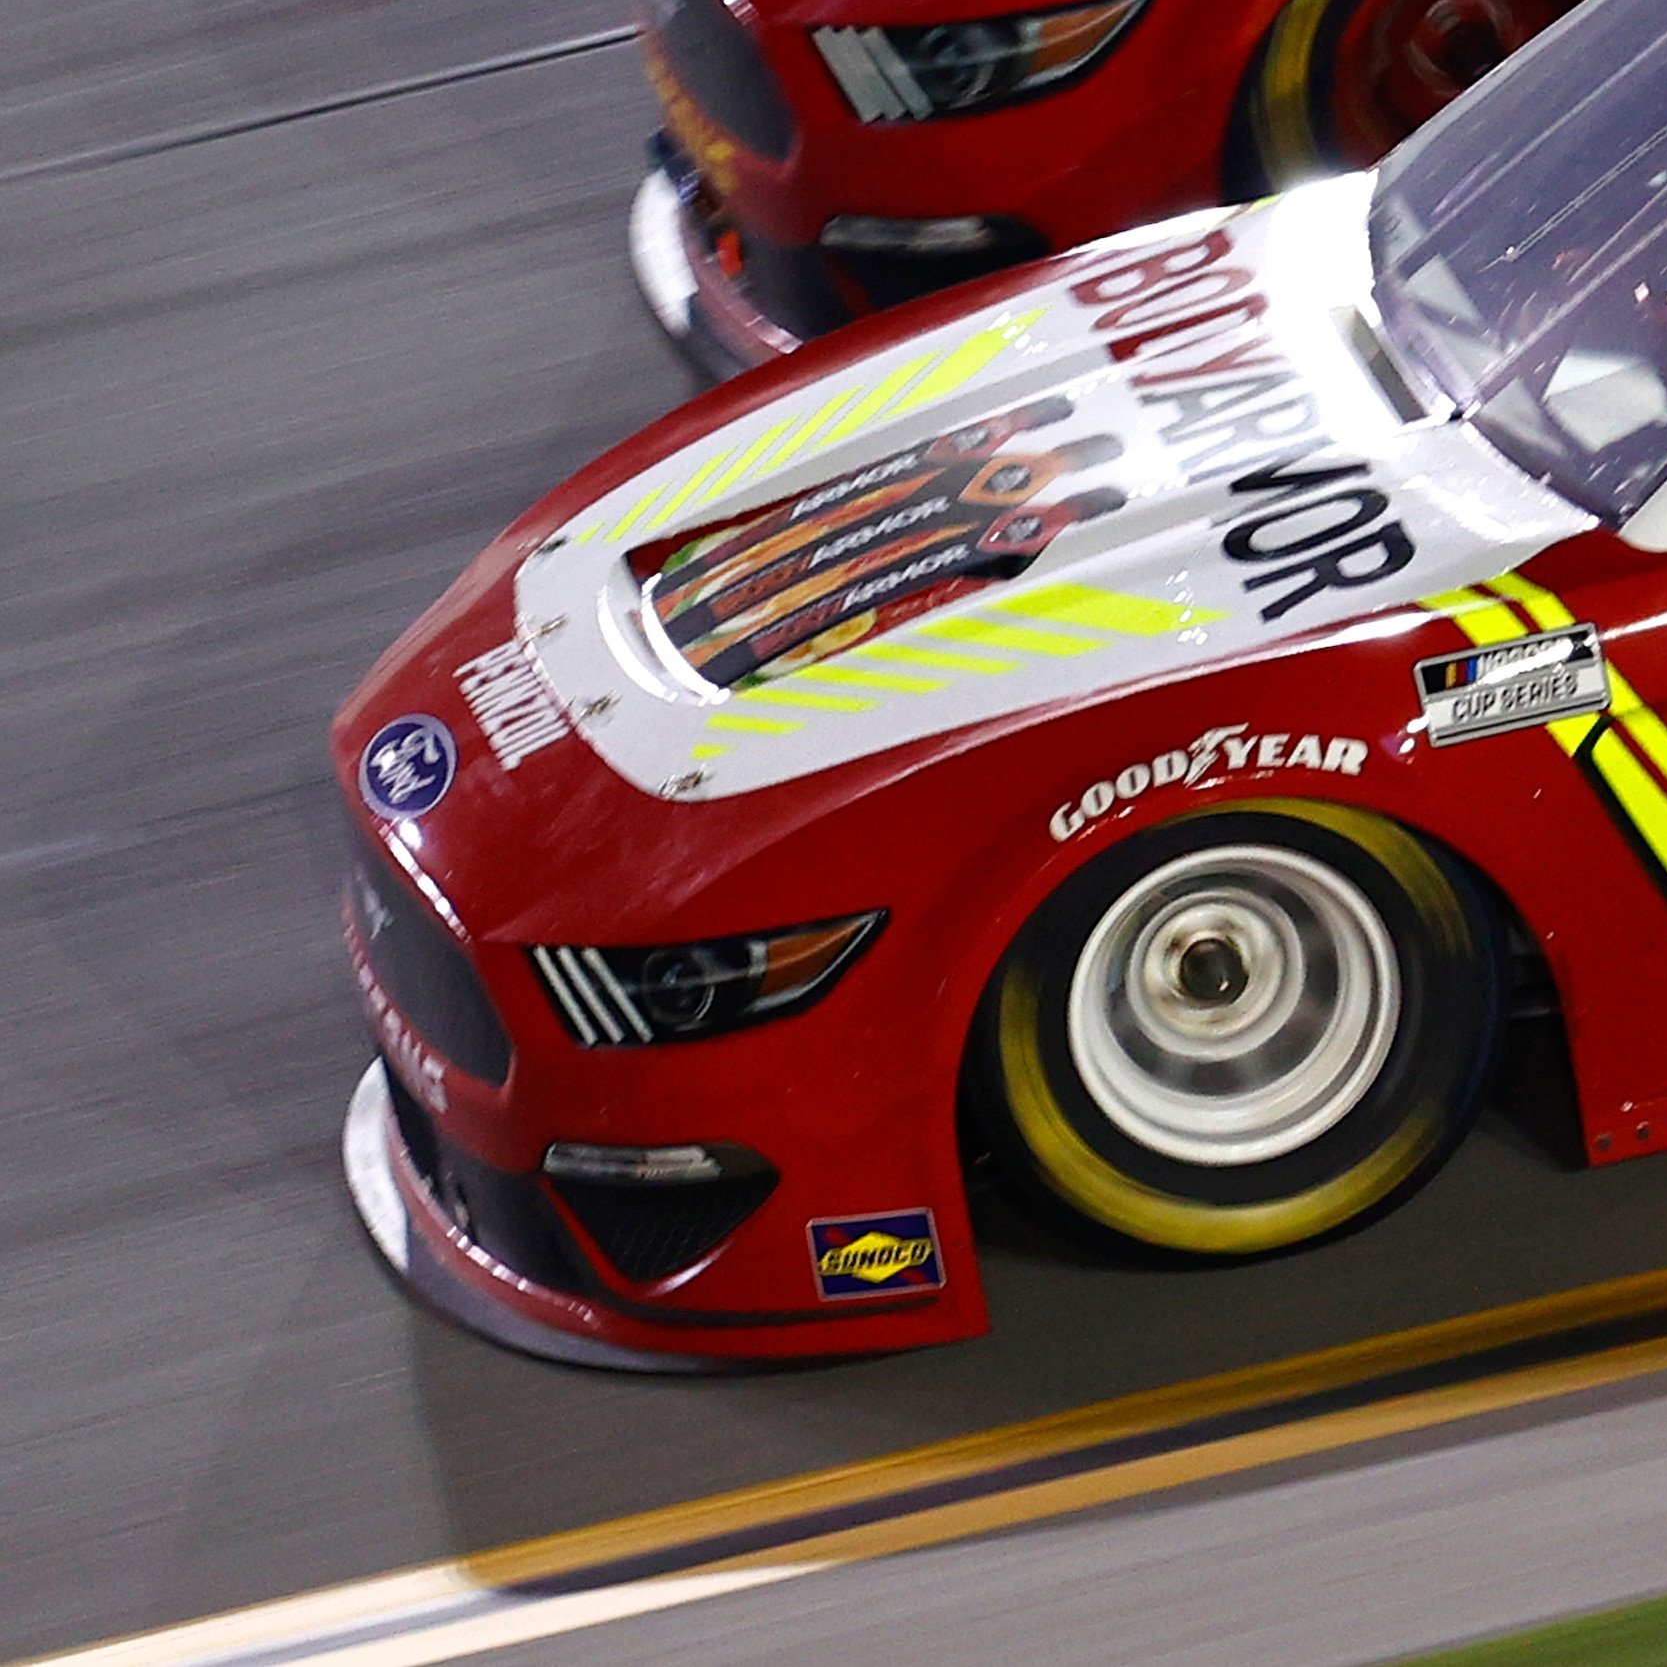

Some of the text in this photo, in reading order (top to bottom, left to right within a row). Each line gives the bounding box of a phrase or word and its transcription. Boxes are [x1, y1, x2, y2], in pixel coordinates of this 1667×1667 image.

[1066, 227, 1418, 624] BODYARMOR
[453, 640, 571, 770] PENNZOIL
[1452, 673, 1578, 719] CUP SERIES
[1049, 723, 1369, 844] GOODYEAR
[820, 1239, 932, 1276] SUNOCO
